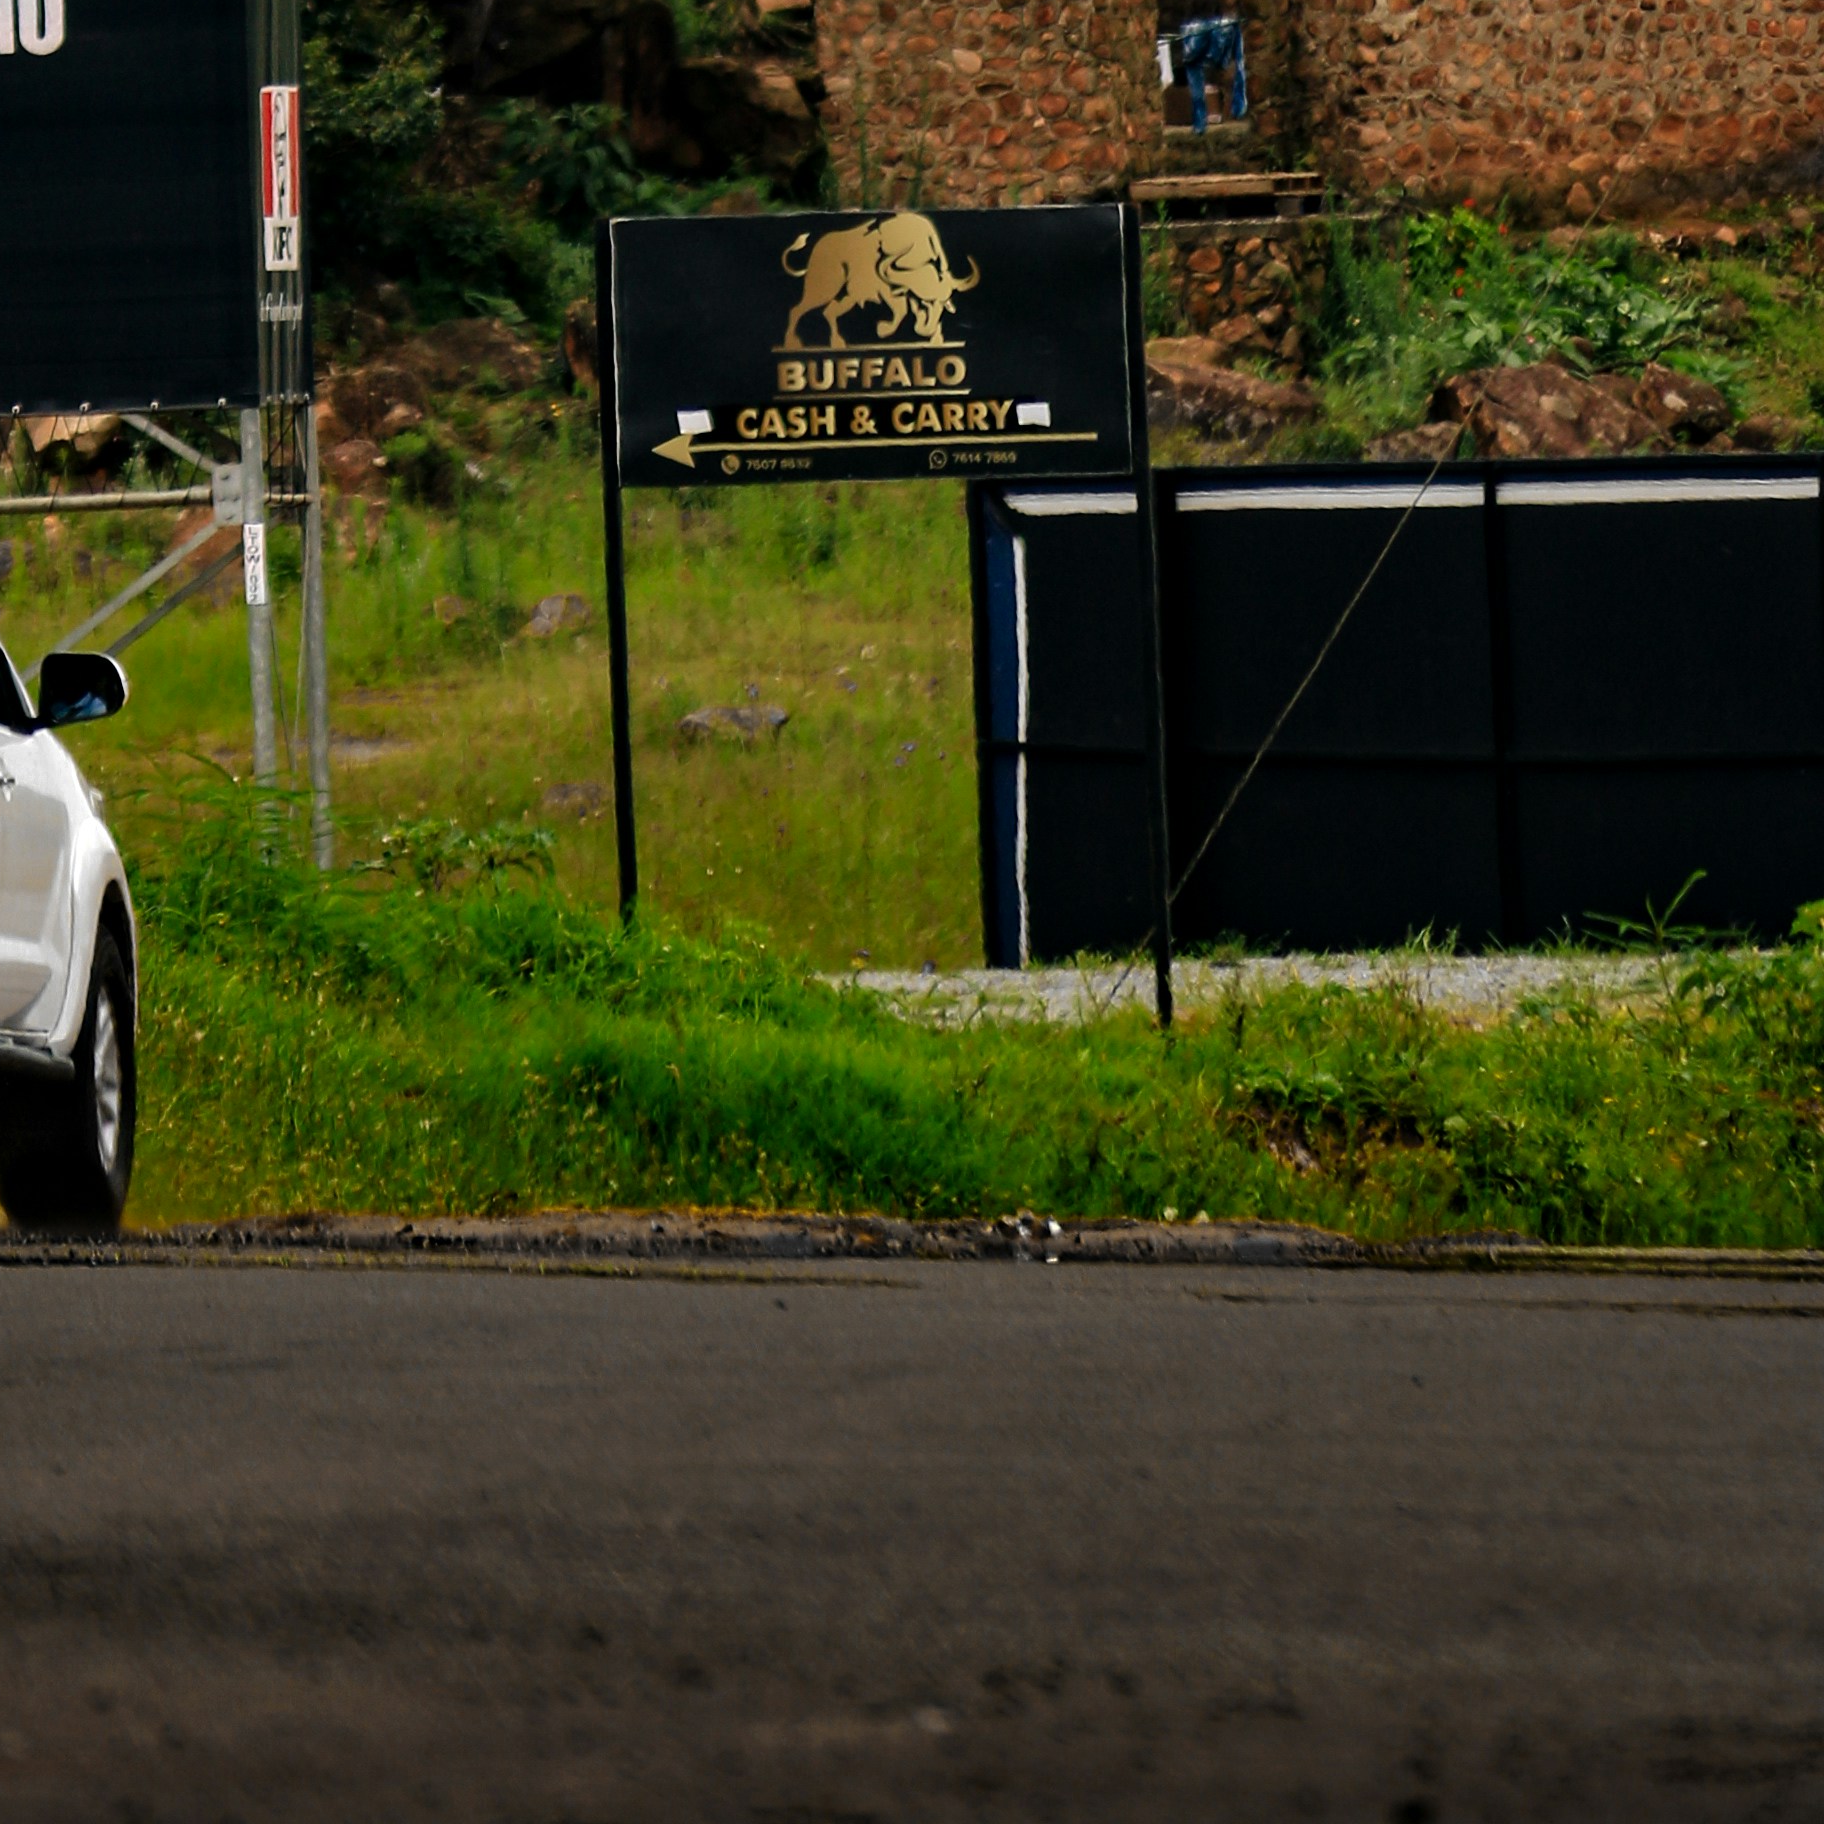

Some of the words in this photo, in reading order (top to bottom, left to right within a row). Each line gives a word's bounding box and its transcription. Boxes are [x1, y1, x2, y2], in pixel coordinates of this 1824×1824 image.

[777, 355, 967, 392] BUFFALO
[736, 404, 836, 440] CASH
[850, 405, 878, 435] &
[891, 399, 1015, 434] CARRY
